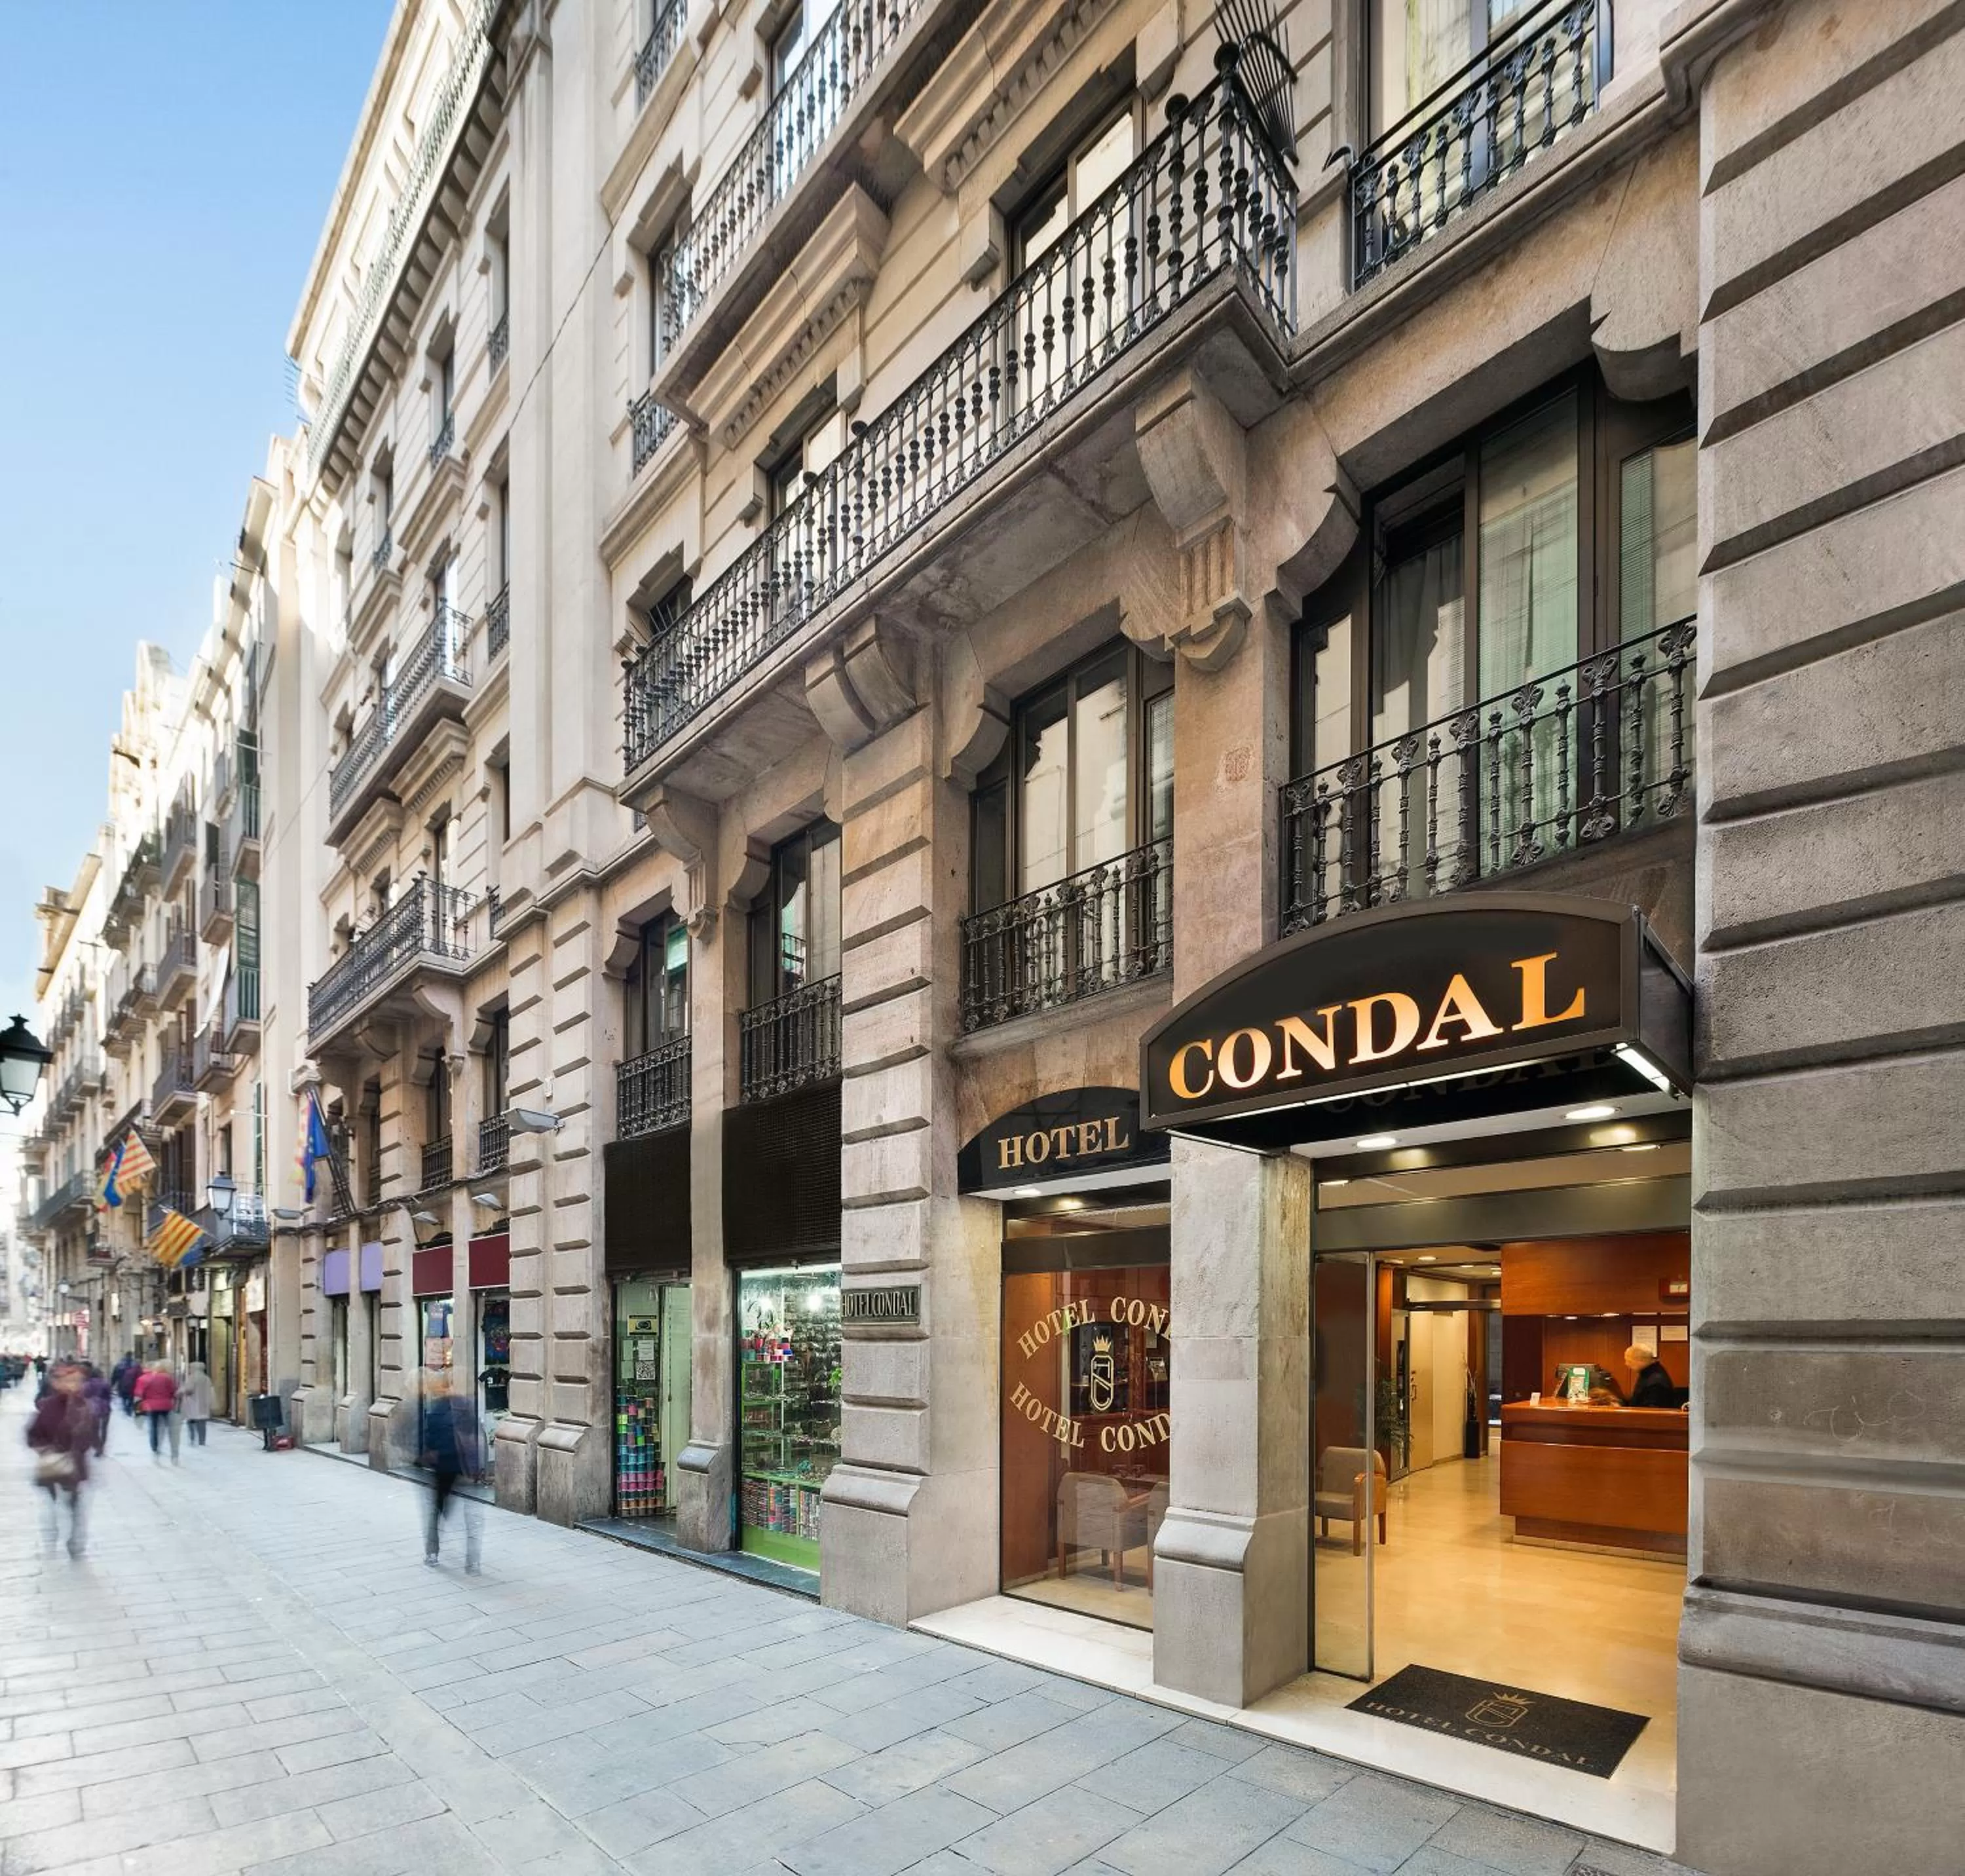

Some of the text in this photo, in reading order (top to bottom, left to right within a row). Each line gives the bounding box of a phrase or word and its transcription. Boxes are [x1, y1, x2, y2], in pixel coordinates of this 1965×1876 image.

[1168, 950, 1586, 1100] CONDAL
[998, 1116, 1129, 1169] HOTEL
[872, 1290, 917, 1316] CONDAL
[1017, 1299, 1096, 1359] HOTEL
[1009, 1381, 1085, 1448] HOTEL
[1365, 1701, 1594, 1768] HOTEL CONDAL
